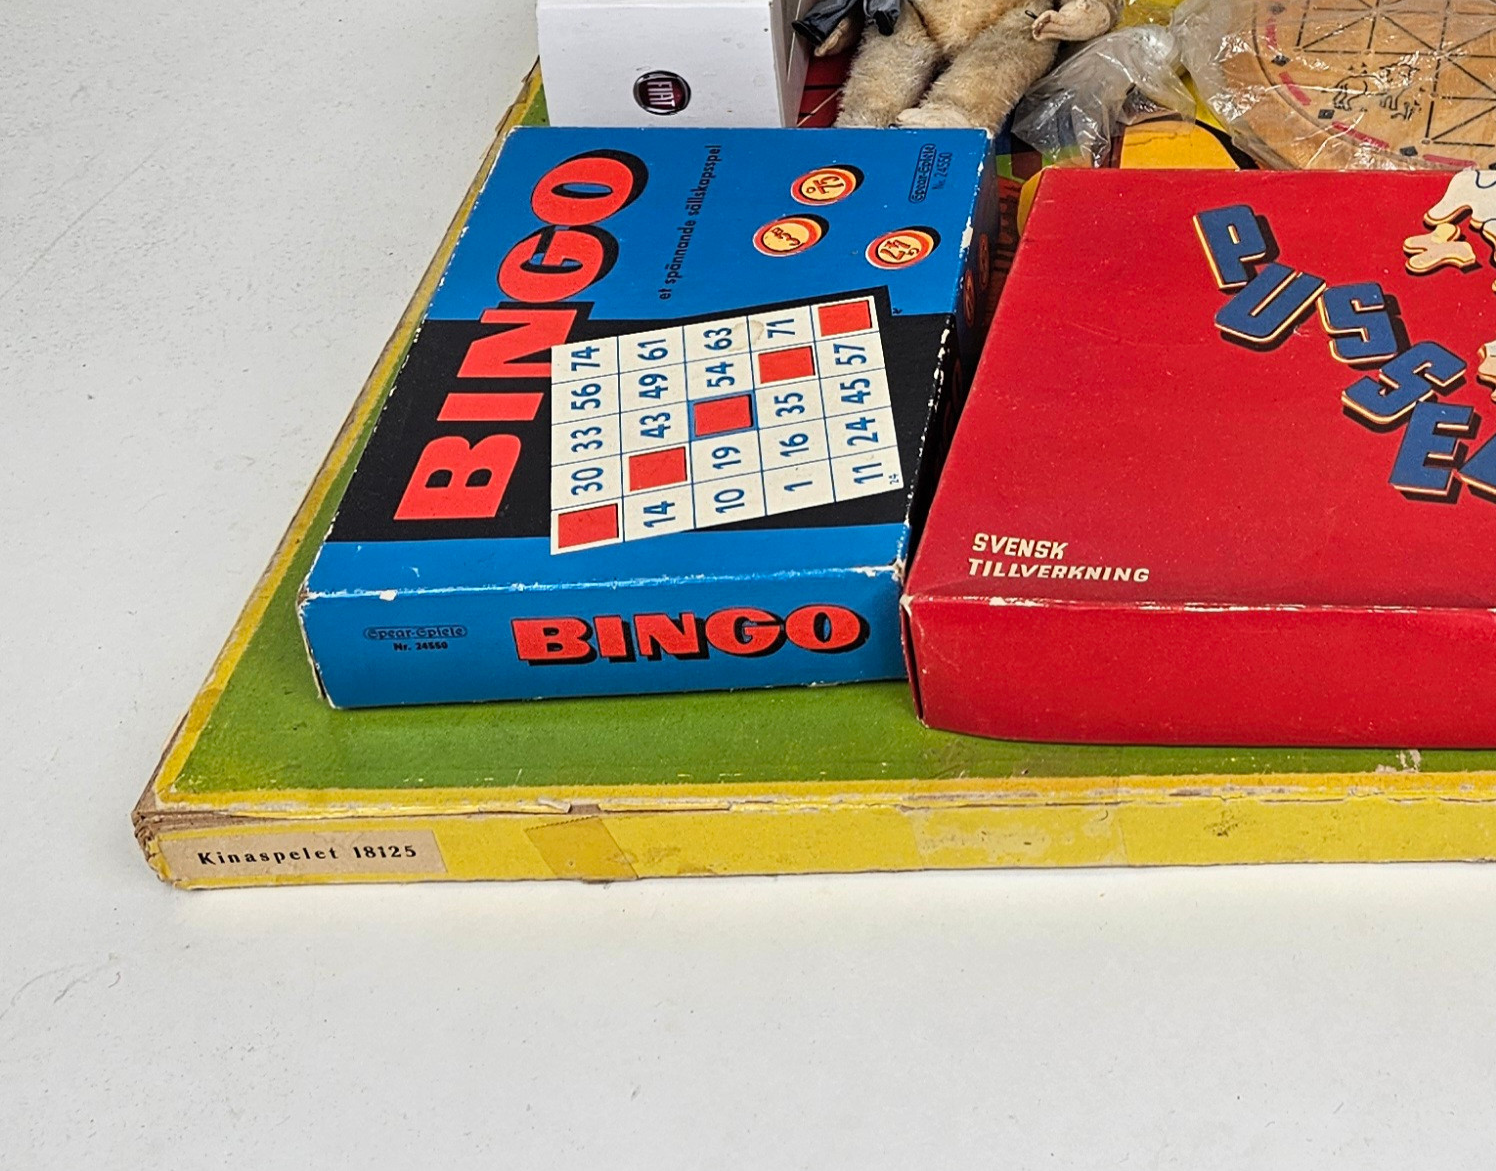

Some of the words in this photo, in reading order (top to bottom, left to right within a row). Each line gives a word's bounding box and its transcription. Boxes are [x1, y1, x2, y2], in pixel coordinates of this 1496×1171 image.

[647, 81, 676, 108] FIAT
[934, 151, 953, 178] 24550
[684, 144, 723, 217] sällskapsspel
[664, 218, 697, 285] spännande
[657, 288, 673, 301] et
[393, 150, 646, 521] BINGO
[703, 327, 733, 351] 63
[767, 317, 796, 338] 71
[570, 345, 601, 372] 74
[637, 338, 669, 361] 61
[833, 342, 867, 366] 57
[638, 373, 669, 400] 49
[706, 361, 736, 388] 54
[570, 382, 602, 412] 56
[775, 391, 806, 418] 35
[840, 377, 871, 405] 45
[639, 412, 671, 439] 43
[846, 416, 879, 447] 24
[570, 425, 604, 454] 33
[779, 432, 810, 458] 16
[711, 446, 741, 470] 19
[570, 466, 604, 496] 30
[784, 480, 813, 493] 1
[853, 461, 884, 485] 11
[643, 500, 676, 528] 14
[715, 487, 745, 514] 10
[972, 532, 1069, 560] SVENSK
[968, 557, 1150, 582] TILLVERKNING
[393, 642, 411, 651] Nr.
[415, 641, 448, 651] 24550
[511, 604, 867, 664] BINGO
[198, 846, 338, 865] Kinaspelet
[352, 844, 417, 859] 18125
